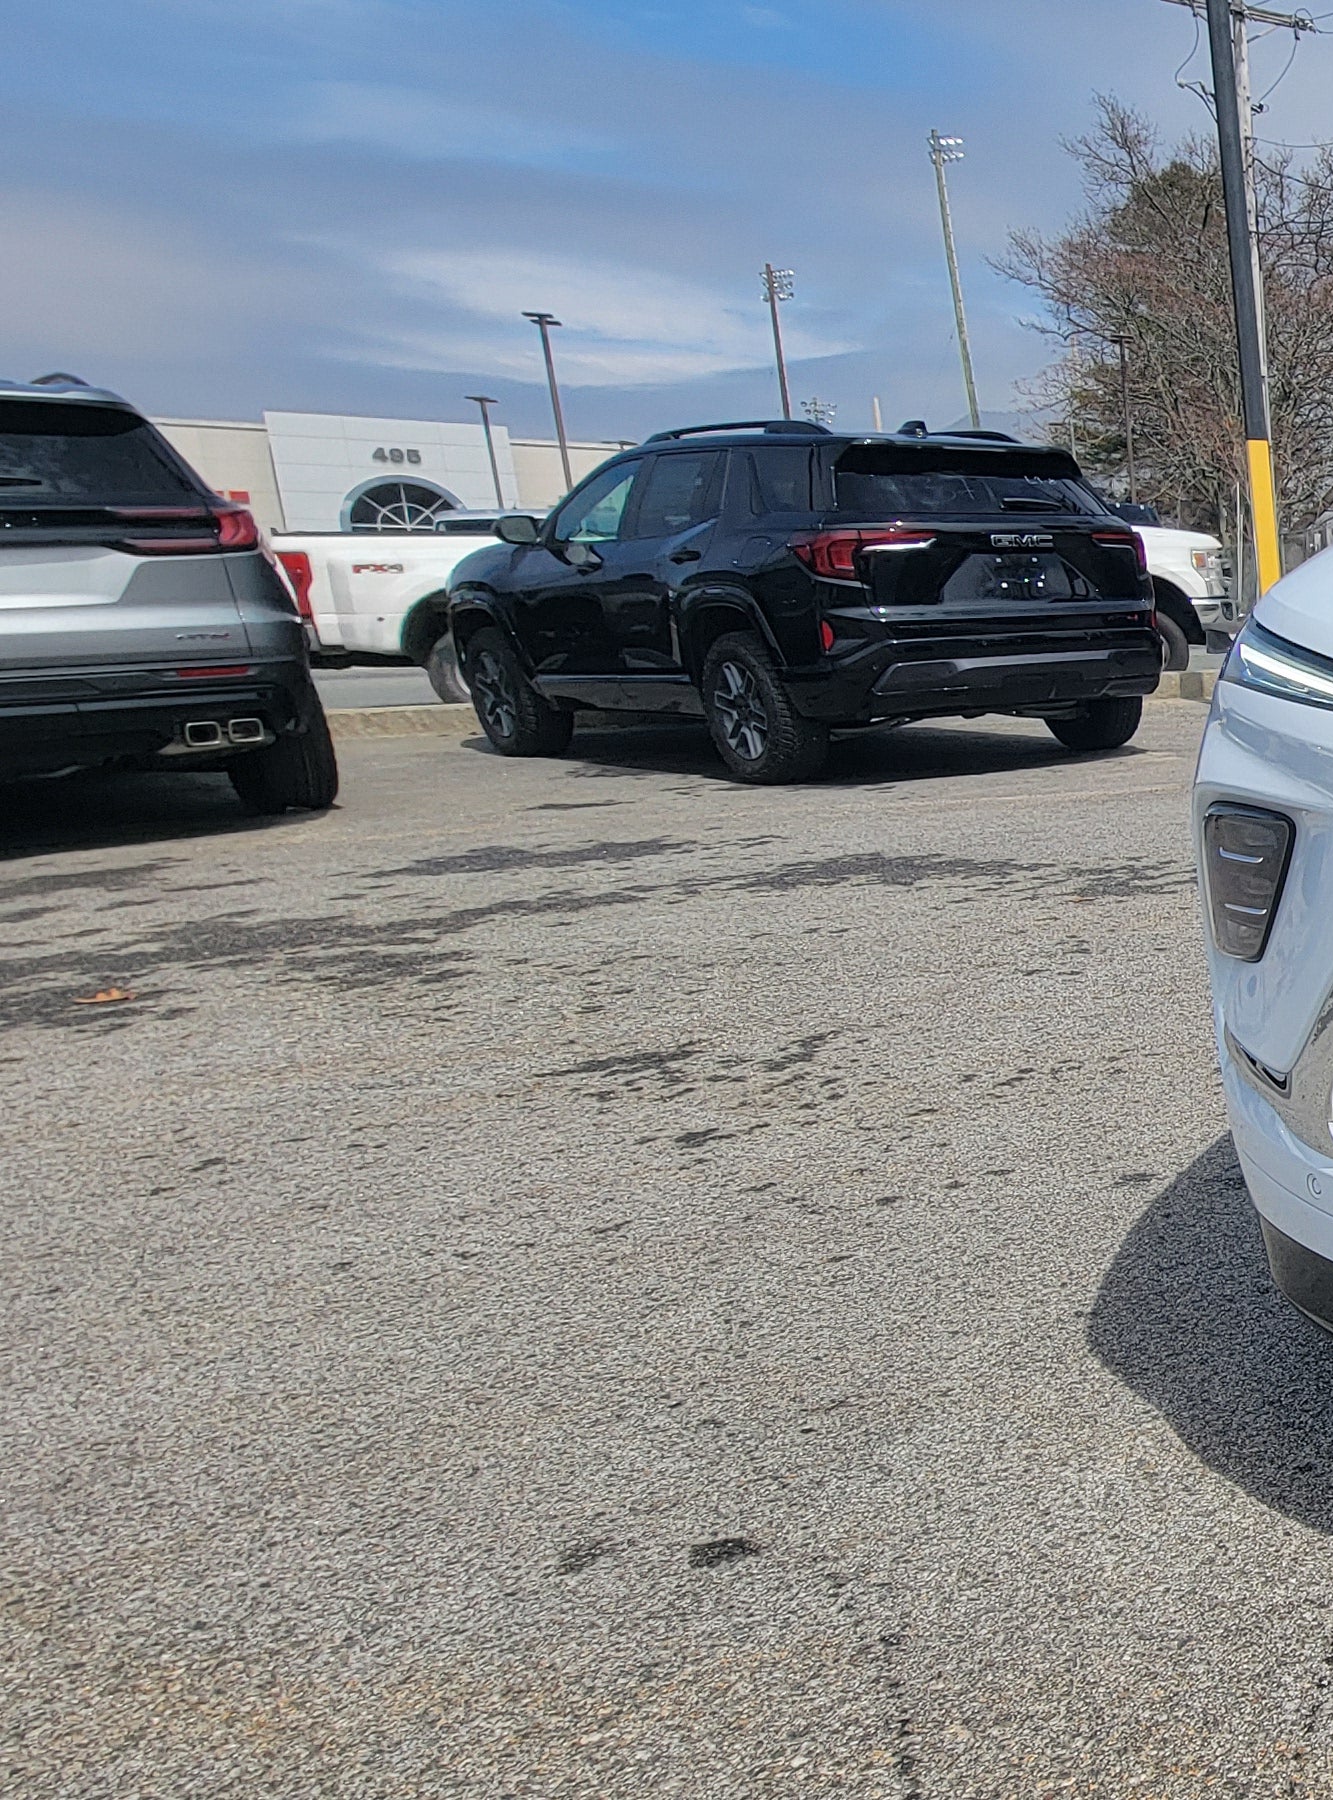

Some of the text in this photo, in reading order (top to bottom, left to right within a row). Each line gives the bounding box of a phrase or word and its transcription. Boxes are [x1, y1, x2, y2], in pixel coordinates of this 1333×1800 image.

[372, 447, 421, 464] 495
[990, 534, 1053, 547] GMC
[352, 563, 404, 573] FX4
